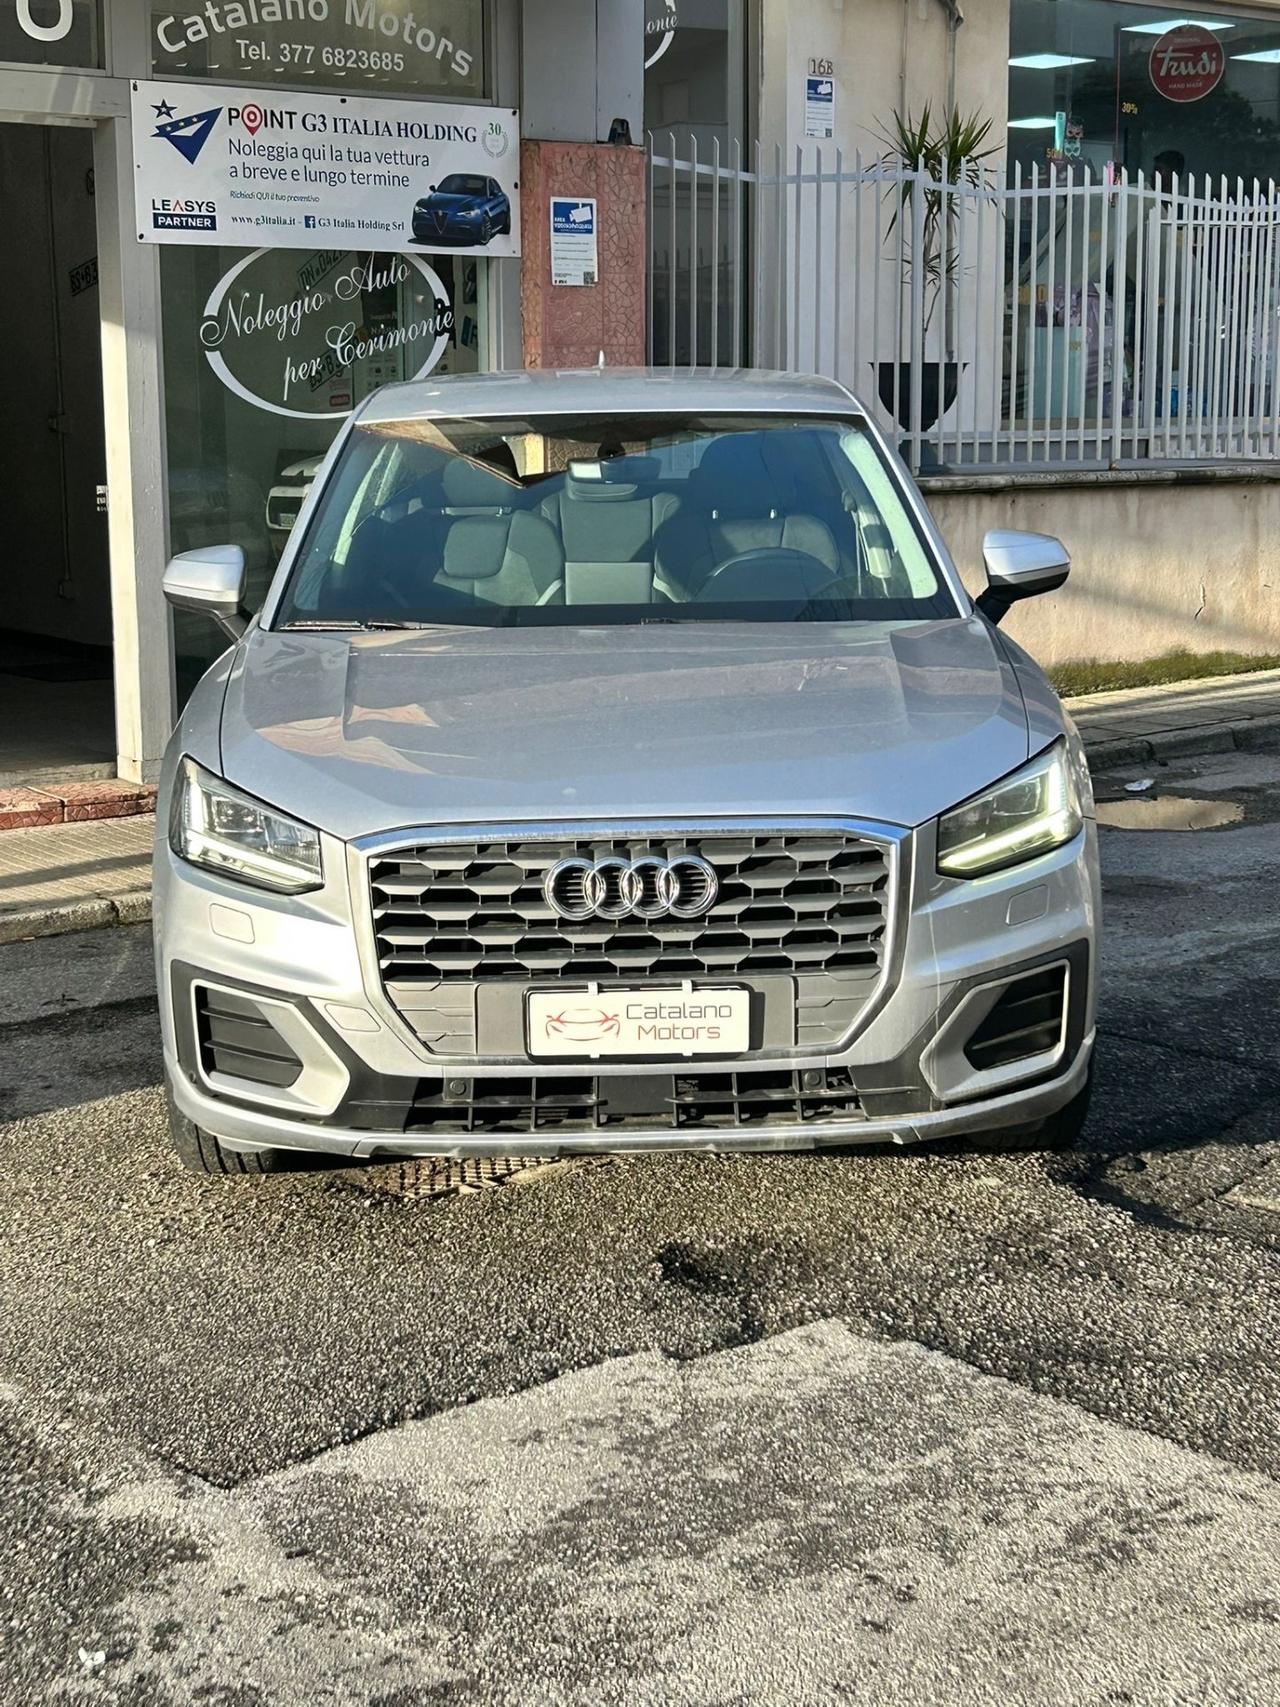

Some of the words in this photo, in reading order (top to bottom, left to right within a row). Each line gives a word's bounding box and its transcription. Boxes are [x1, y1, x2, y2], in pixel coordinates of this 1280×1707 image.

[156, 0, 329, 53] Catalano
[345, 0, 474, 77] Motors
[235, 39, 271, 61] Tel.
[279, 43, 315, 64] 377
[322, 47, 405, 72] 6823685
[811, 58, 834, 75] 16B
[1156, 46, 1217, 77] Trudi
[228, 104, 298, 133] POINT
[301, 113, 328, 133] G3
[333, 117, 393, 138] ITALIA
[397, 121, 478, 143] HOLDING
[229, 138, 299, 162] Noleggia
[302, 144, 326, 164] qui
[330, 144, 343, 162] la
[347, 147, 372, 164] tua
[375, 149, 430, 167] vettura
[229, 165, 238, 178] a
[243, 162, 288, 181] breve
[291, 169, 300, 181] e
[304, 165, 347, 187] lungo
[350, 170, 410, 188] termine
[152, 199, 216, 213] LEASYS
[158, 216, 212, 228] PARTNER
[318, 217, 331, 228] G3
[334, 218, 356, 229] Italia
[358, 219, 391, 231] Holding
[392, 221, 405, 231] Srl
[200, 285, 326, 347] Noleggio
[335, 251, 411, 300] Auto
[284, 357, 322, 401] per
[325, 303, 455, 365] Cerimonie
[626, 1002, 732, 1020] Catalano
[637, 1023, 721, 1041] Motors
